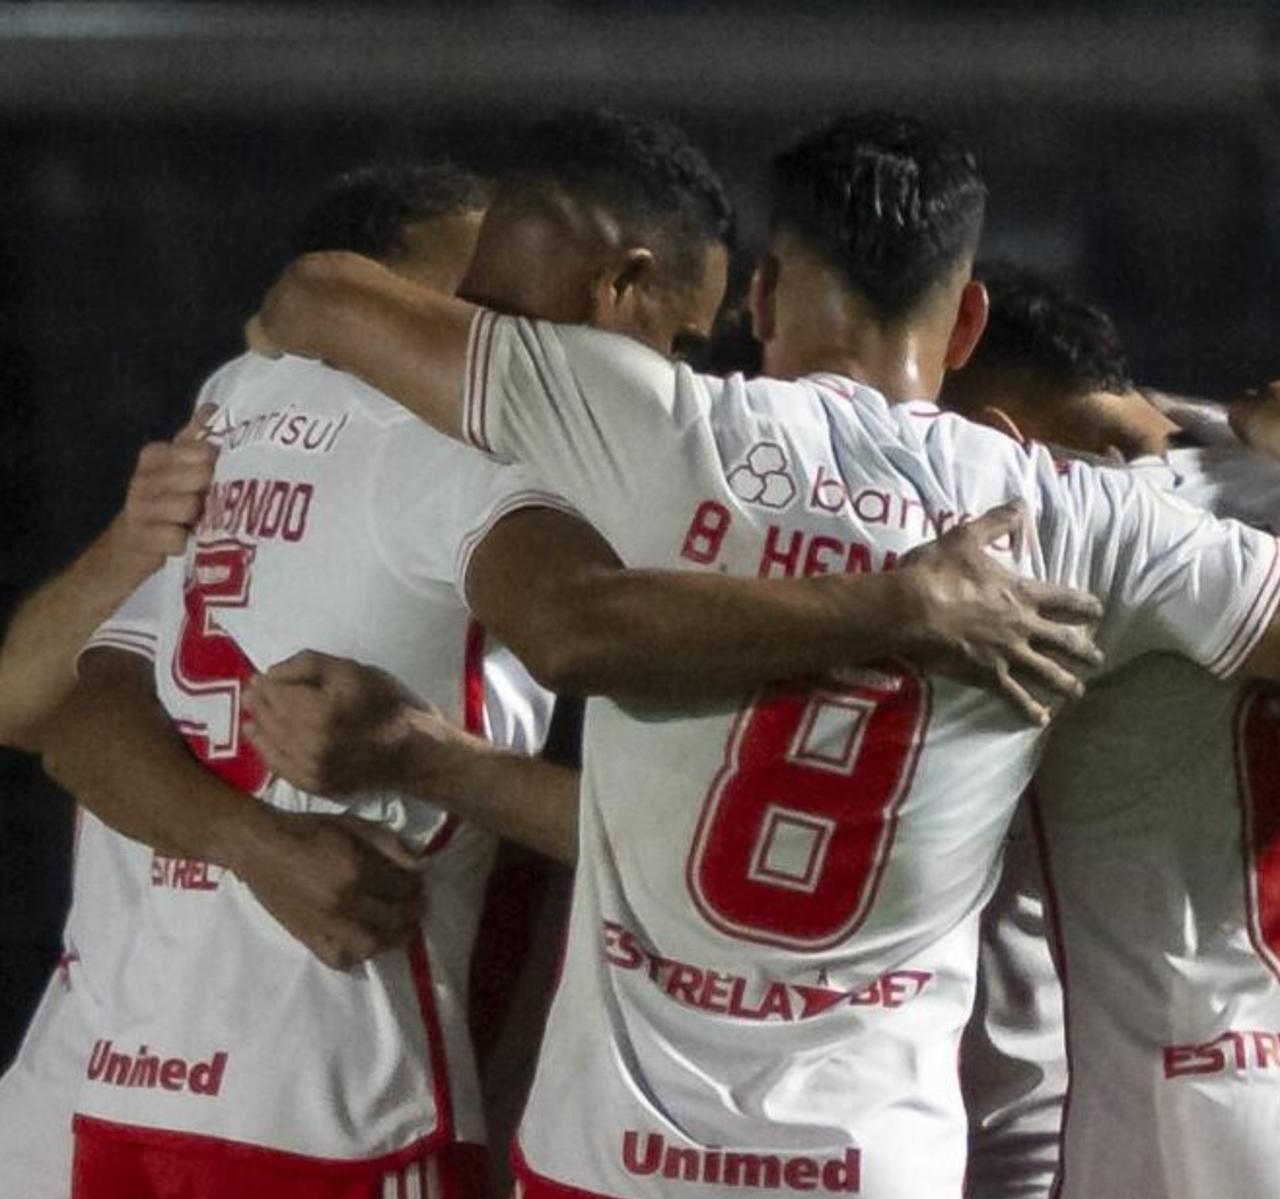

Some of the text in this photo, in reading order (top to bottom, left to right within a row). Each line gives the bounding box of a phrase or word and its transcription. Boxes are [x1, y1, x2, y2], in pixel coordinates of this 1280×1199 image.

[686, 655, 936, 953] 8
[87, 1039, 228, 1096] Unimed
[622, 1129, 862, 1193] Unimed
